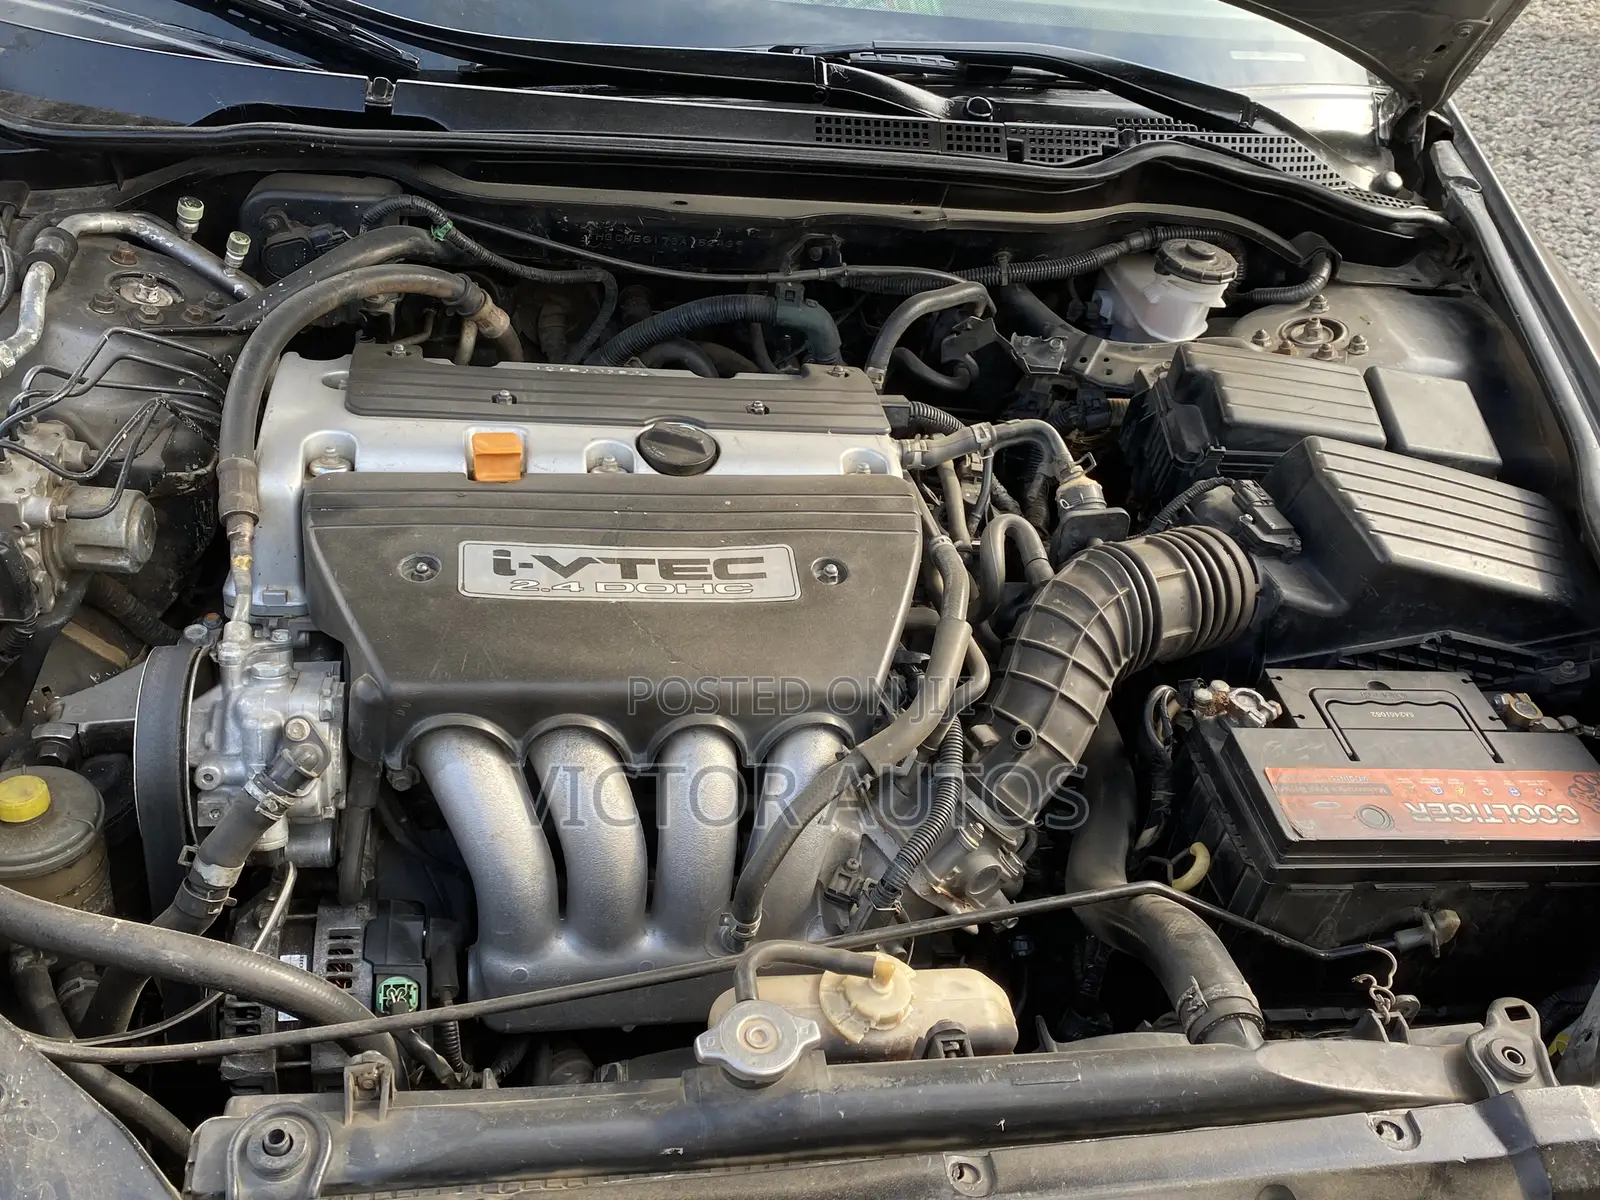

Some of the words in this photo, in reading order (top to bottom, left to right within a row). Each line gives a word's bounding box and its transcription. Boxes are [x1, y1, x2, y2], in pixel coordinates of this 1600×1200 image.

[493, 548, 767, 581] i-VTEC
[510, 579, 585, 594] 2.4
[595, 580, 754, 595] DOHC
[1404, 801, 1581, 825] COOLTIGER
